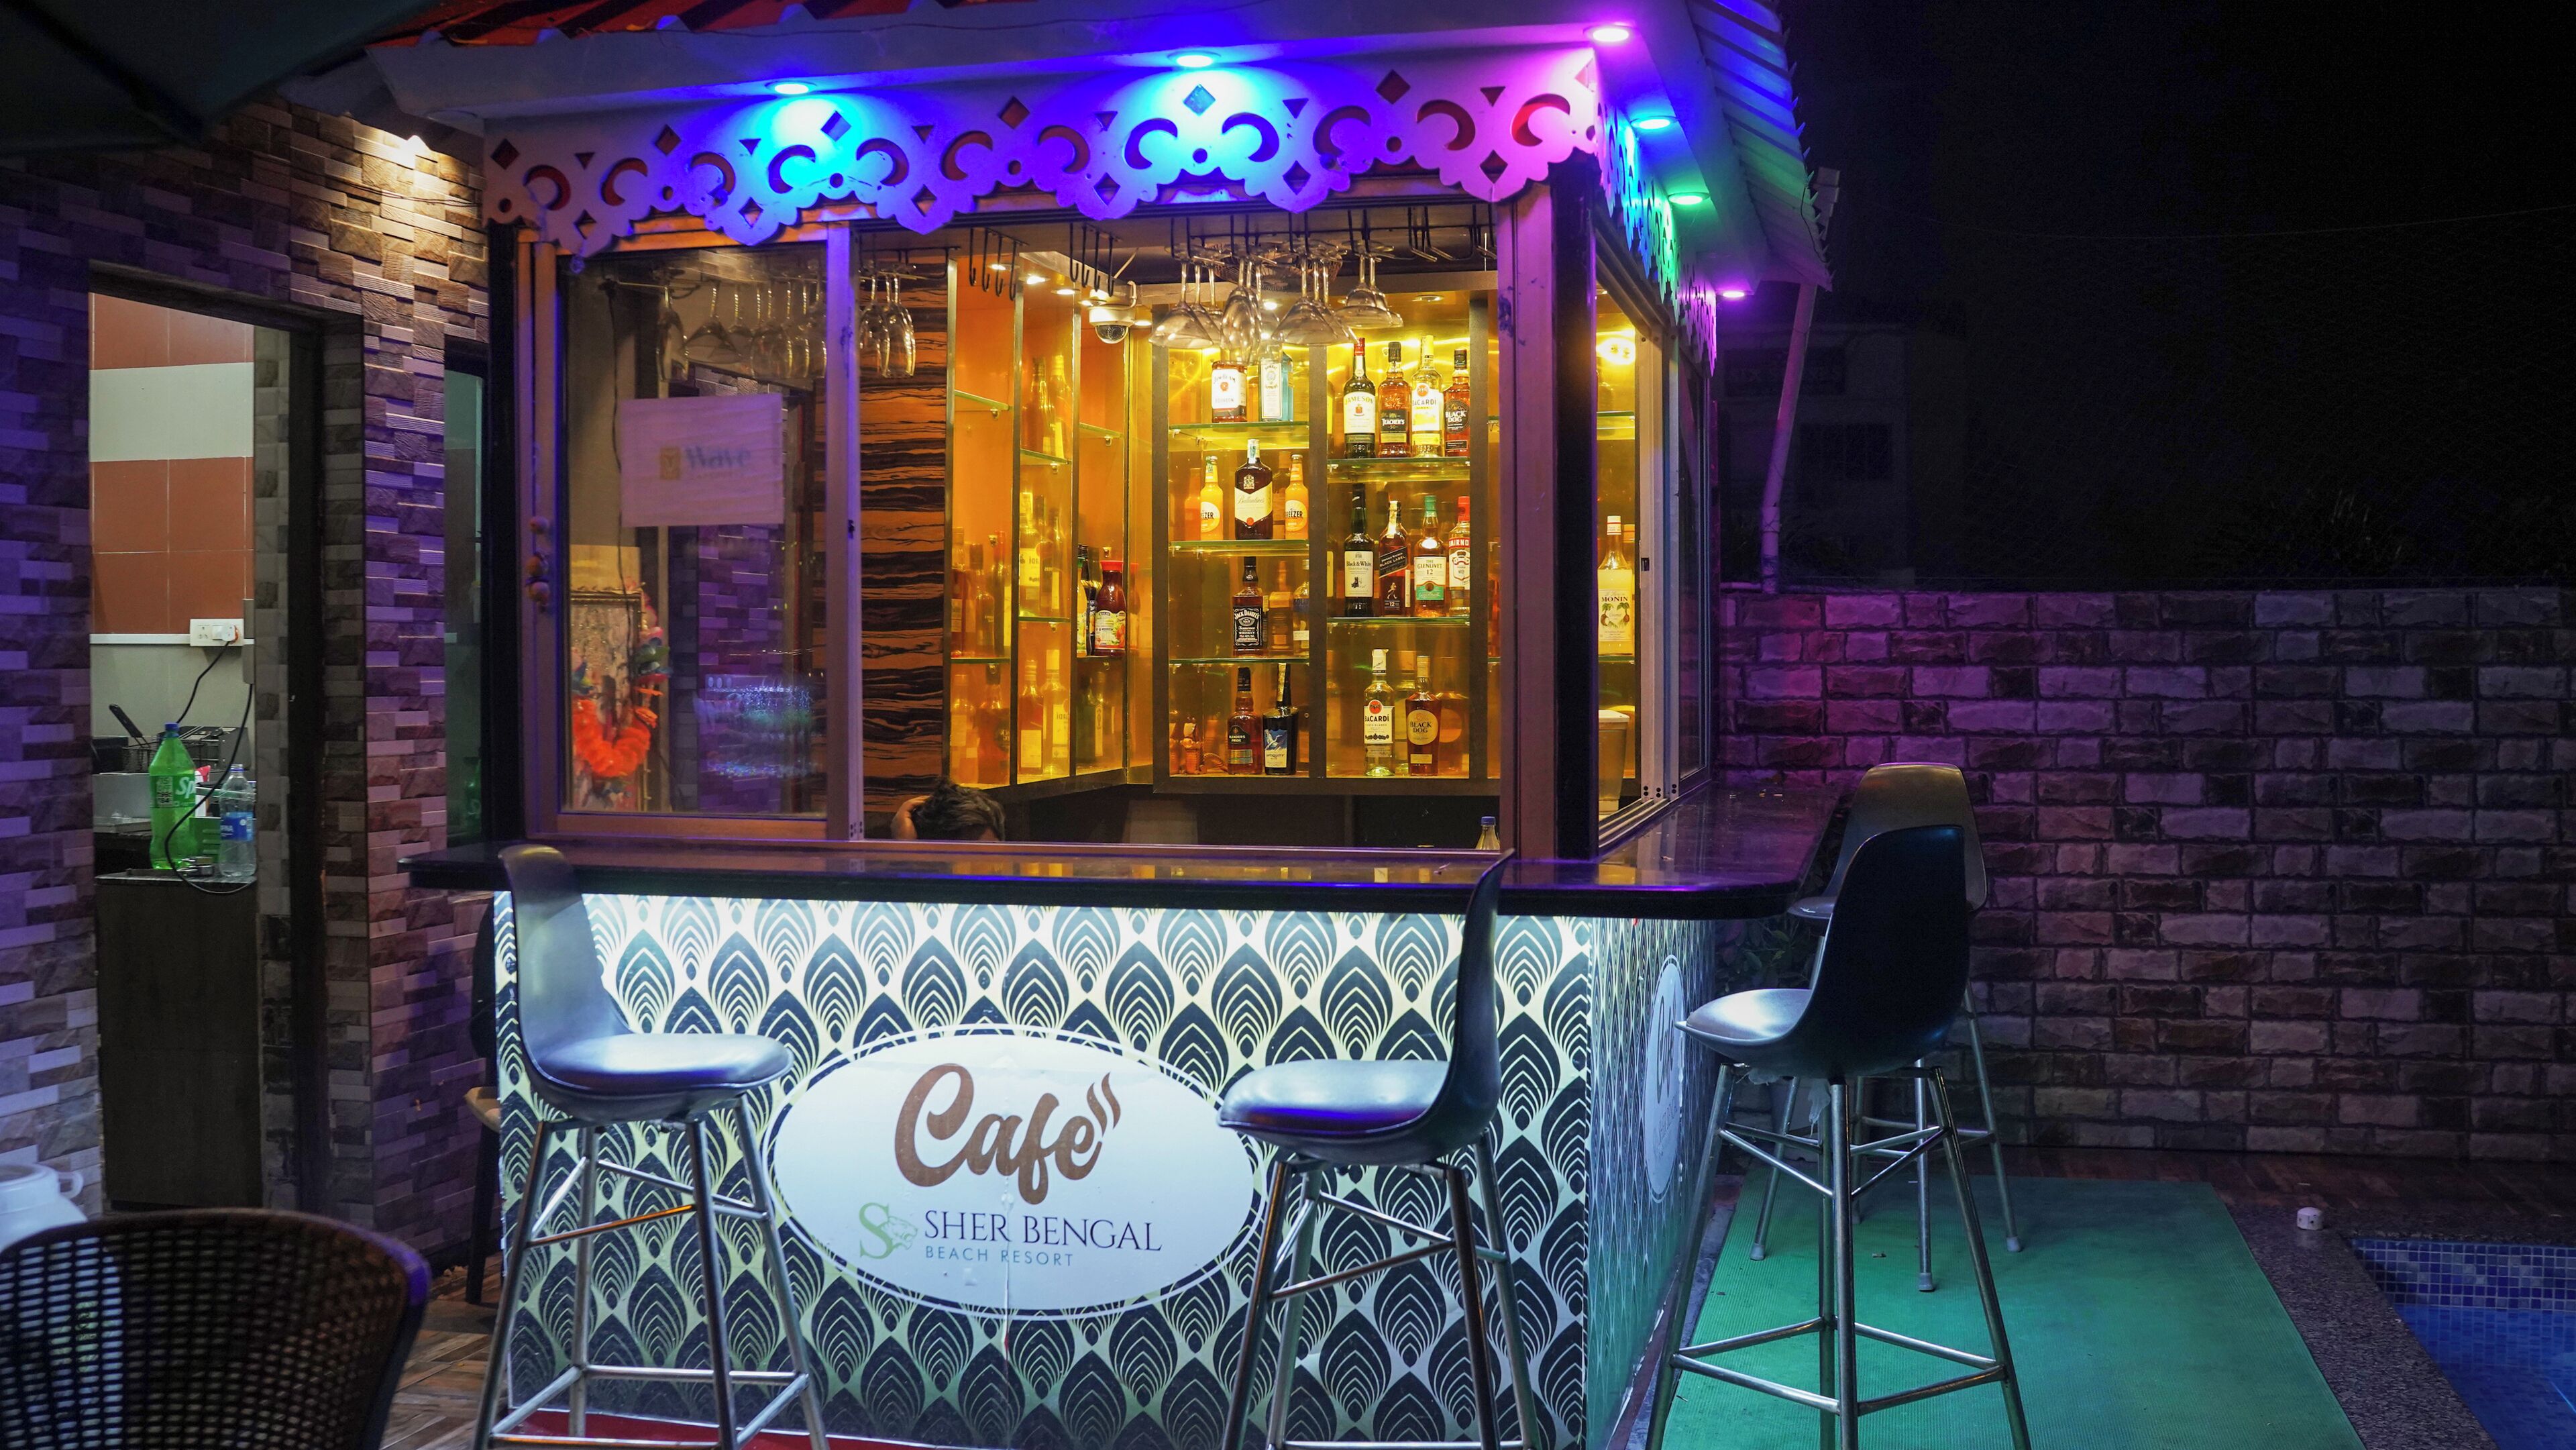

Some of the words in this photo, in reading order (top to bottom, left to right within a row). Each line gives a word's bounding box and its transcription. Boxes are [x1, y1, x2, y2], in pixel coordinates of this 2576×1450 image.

[1344, 396, 1373, 405] JAMESON
[1234, 611, 1244, 620] JACK
[1364, 714, 1390, 722] BACARDÍ
[895, 1063, 1103, 1204] Cafe
[924, 1210, 1011, 1243] SHER
[1022, 1215, 1163, 1251] BENGAL
[926, 1246, 989, 1262] BEACH
[1001, 1249, 1073, 1267] RESORT
